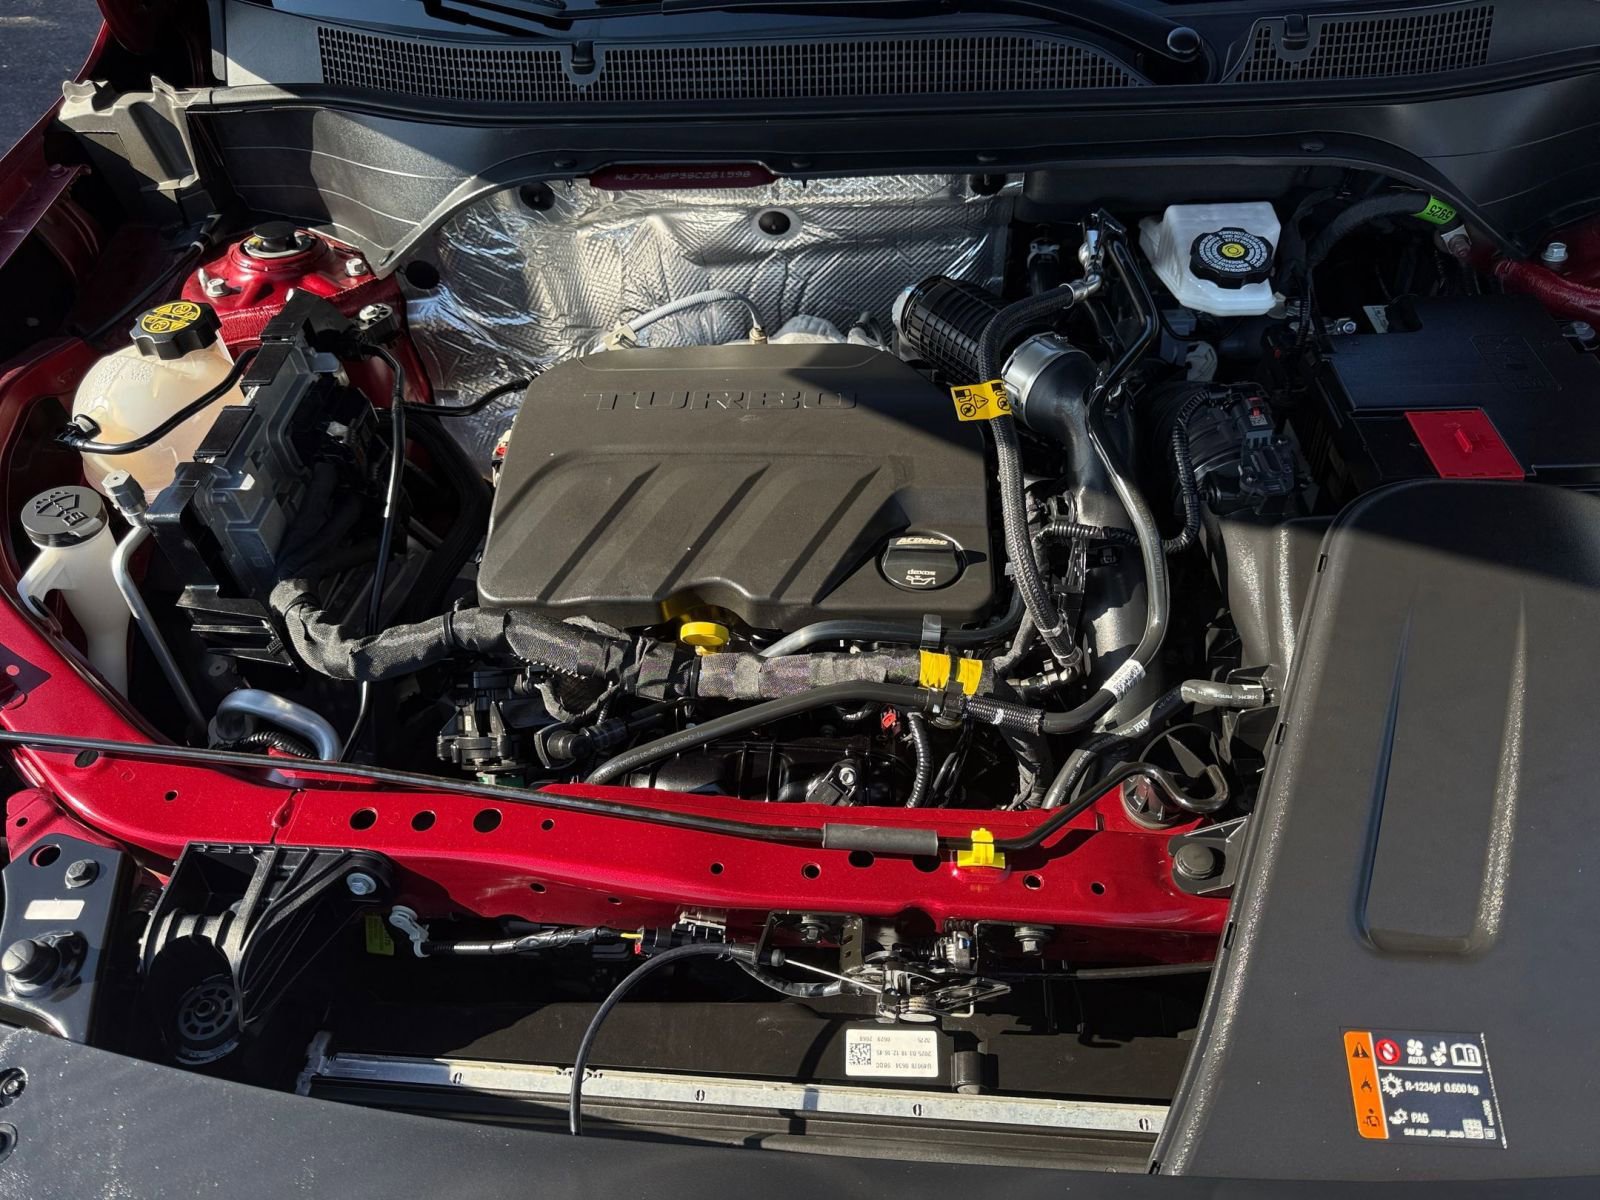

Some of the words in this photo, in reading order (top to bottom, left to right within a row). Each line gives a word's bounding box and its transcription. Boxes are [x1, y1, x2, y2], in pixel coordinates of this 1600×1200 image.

[1425, 204, 1454, 221] 5925
[583, 391, 857, 410] TURBO
[896, 536, 948, 546] ACDelco
[907, 568, 936, 576] dexos
[1407, 1055, 1428, 1065] AUTO
[1404, 1080, 1441, 1095] R-1234yf
[1467, 1083, 1480, 1096] kg
[1410, 1111, 1430, 1124] PAG
